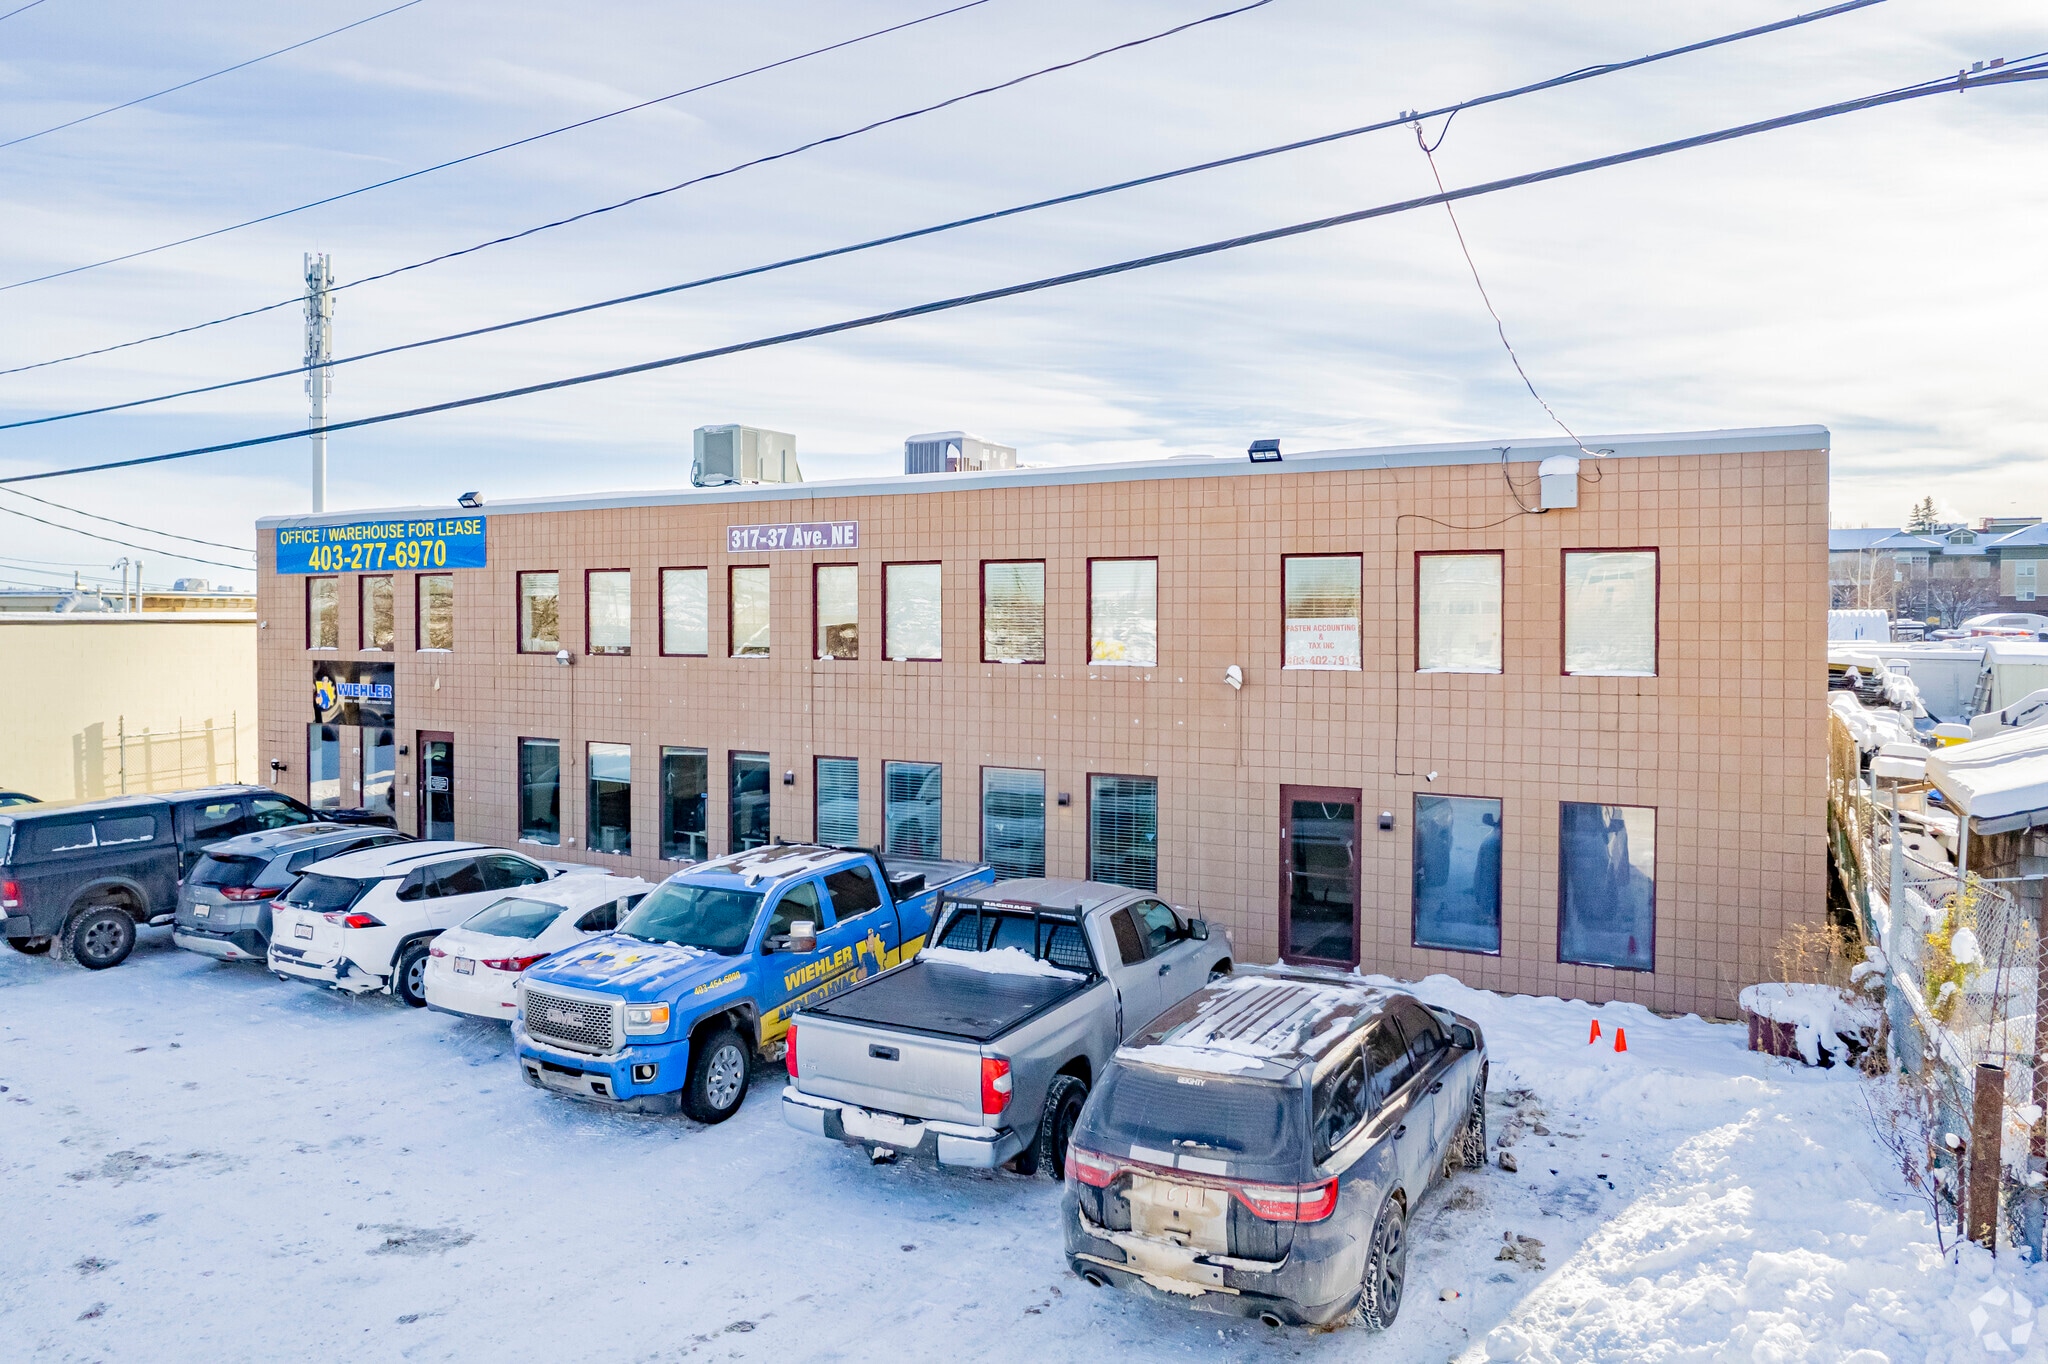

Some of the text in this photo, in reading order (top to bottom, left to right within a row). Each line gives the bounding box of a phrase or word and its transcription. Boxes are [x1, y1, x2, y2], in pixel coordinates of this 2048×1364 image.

[280, 519, 481, 545] OFFICE / WAREHOUSE FOR LEASE
[731, 525, 854, 548] 317-37 Ave. NE
[308, 540, 447, 571] 403-277-6970
[337, 683, 392, 698] WIEHLER
[784, 946, 853, 991] WIEHLER
